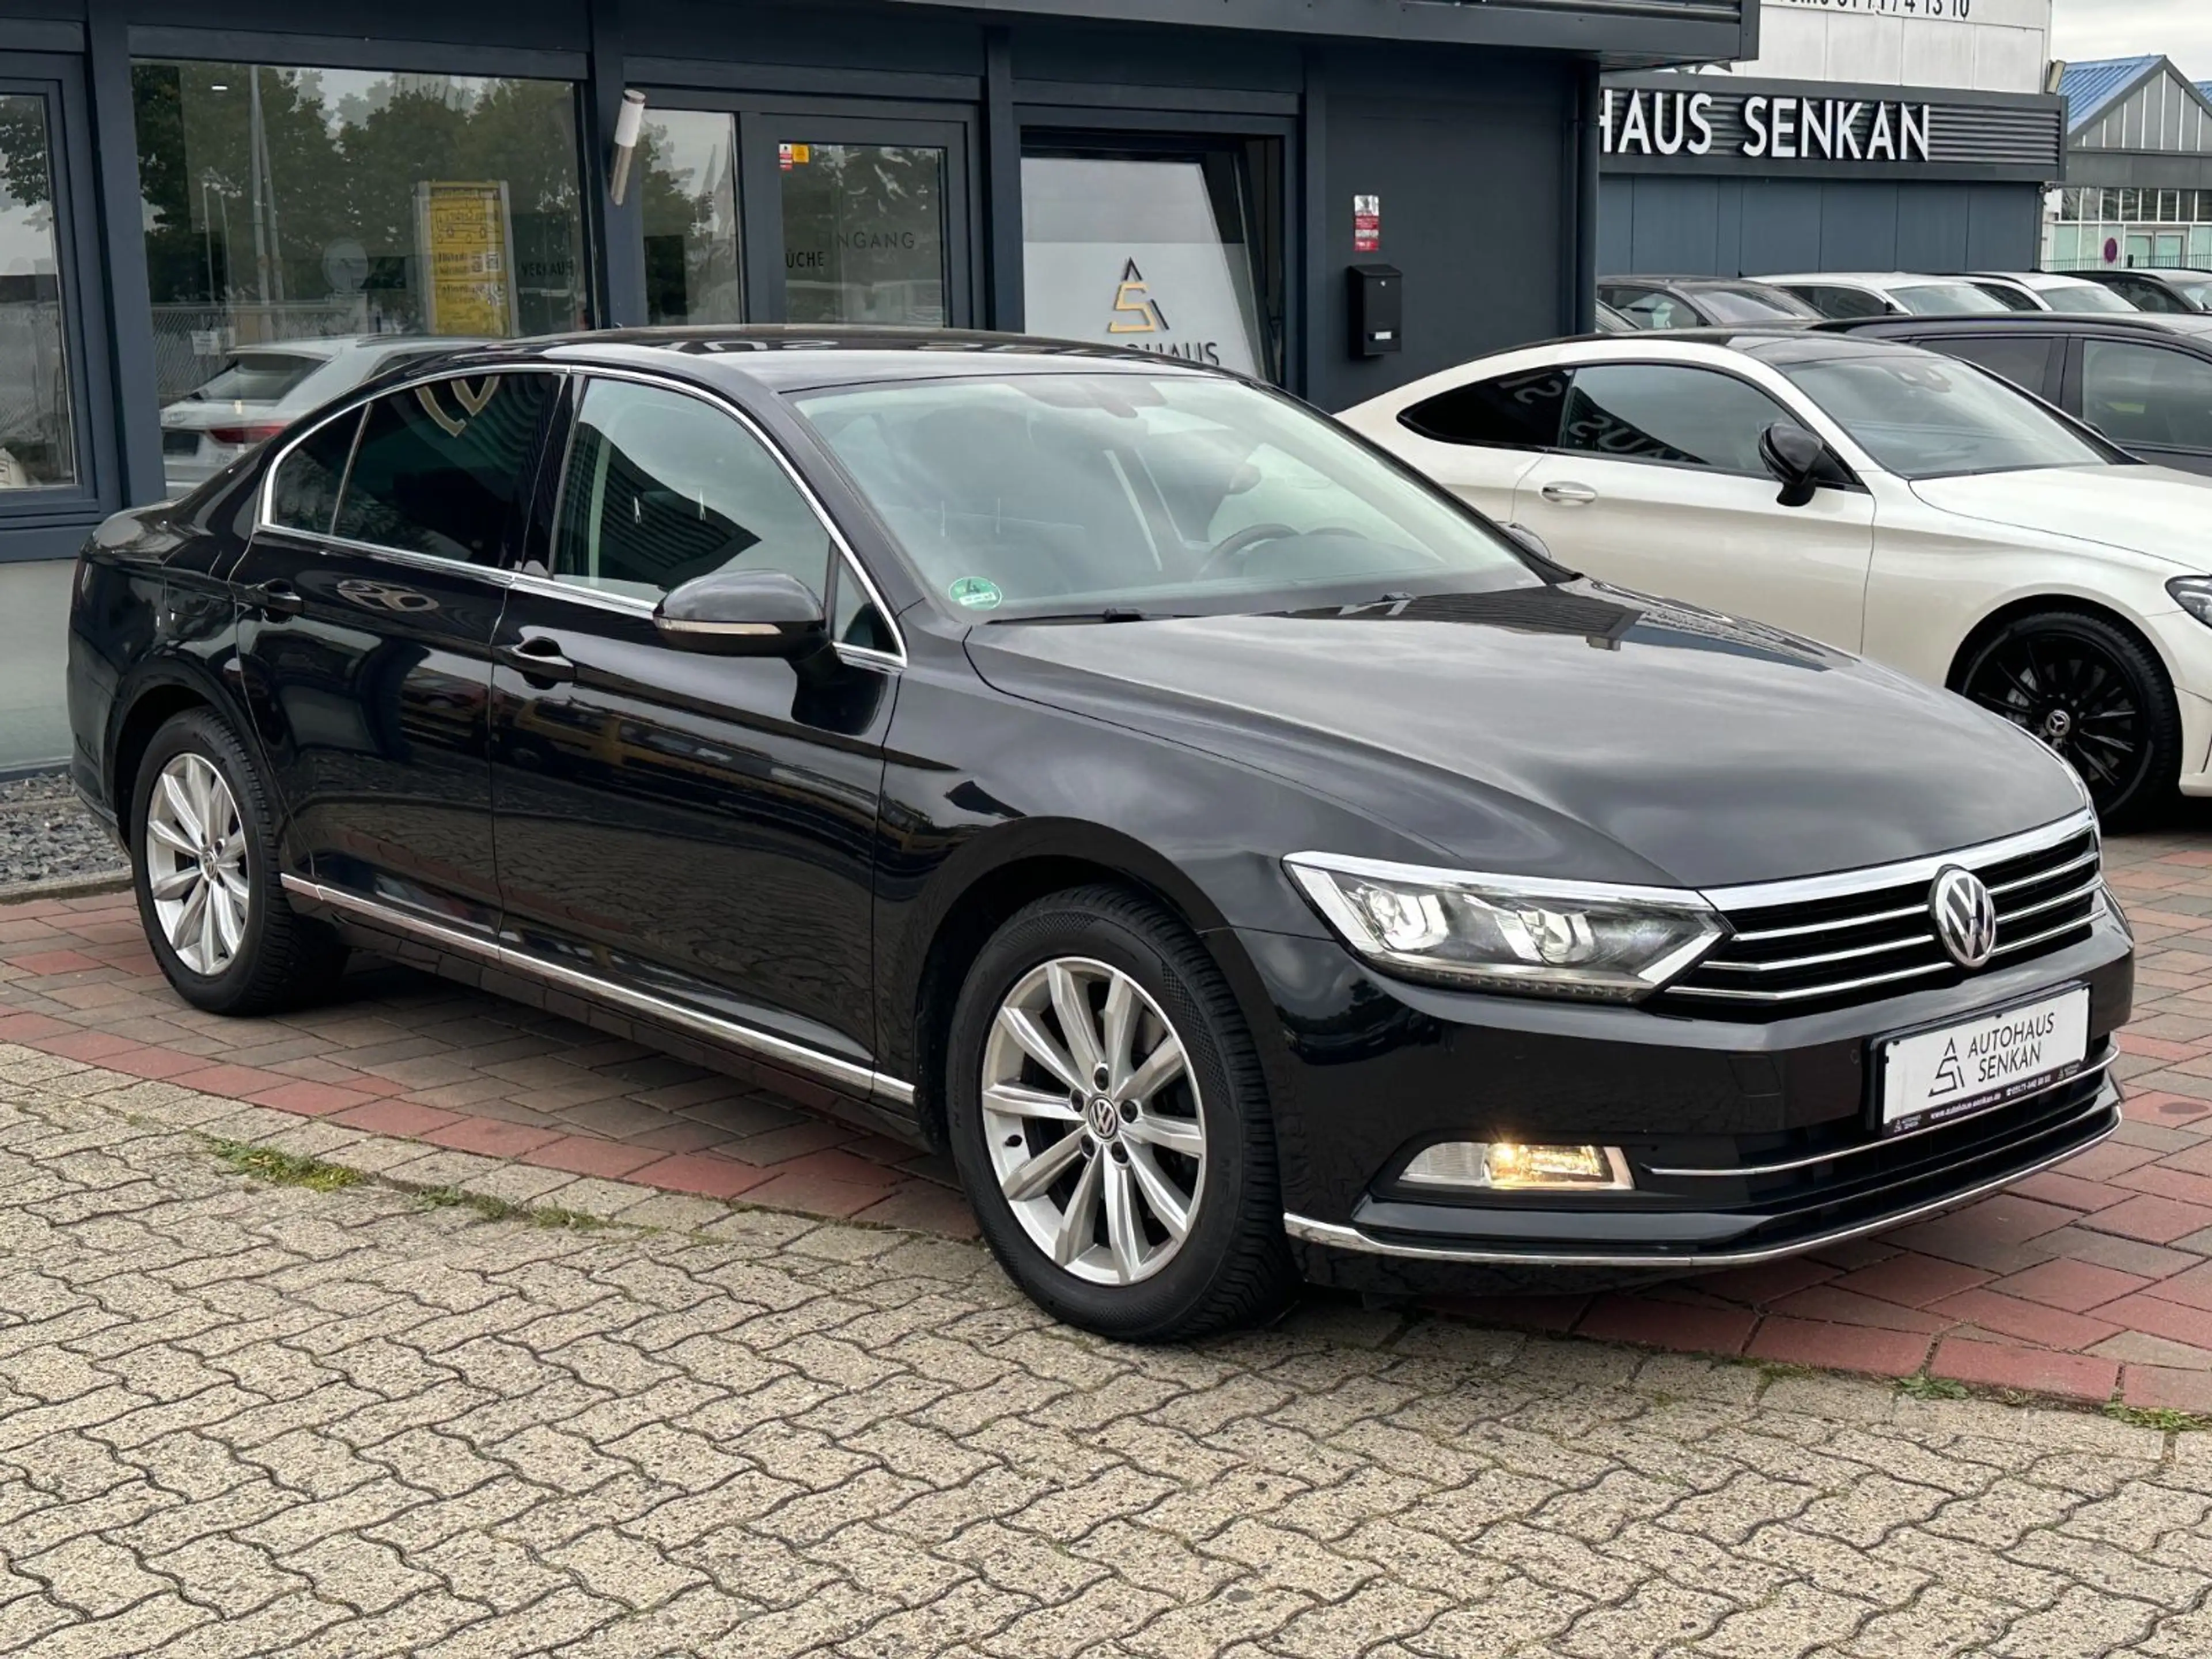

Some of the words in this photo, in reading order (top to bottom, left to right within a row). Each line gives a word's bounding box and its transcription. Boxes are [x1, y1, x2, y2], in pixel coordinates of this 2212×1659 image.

[1743, 96, 1929, 161] SENKAN
[1968, 1012, 2054, 1059] AUTOHAUS
[1978, 1041, 2041, 1082] SENKAN
